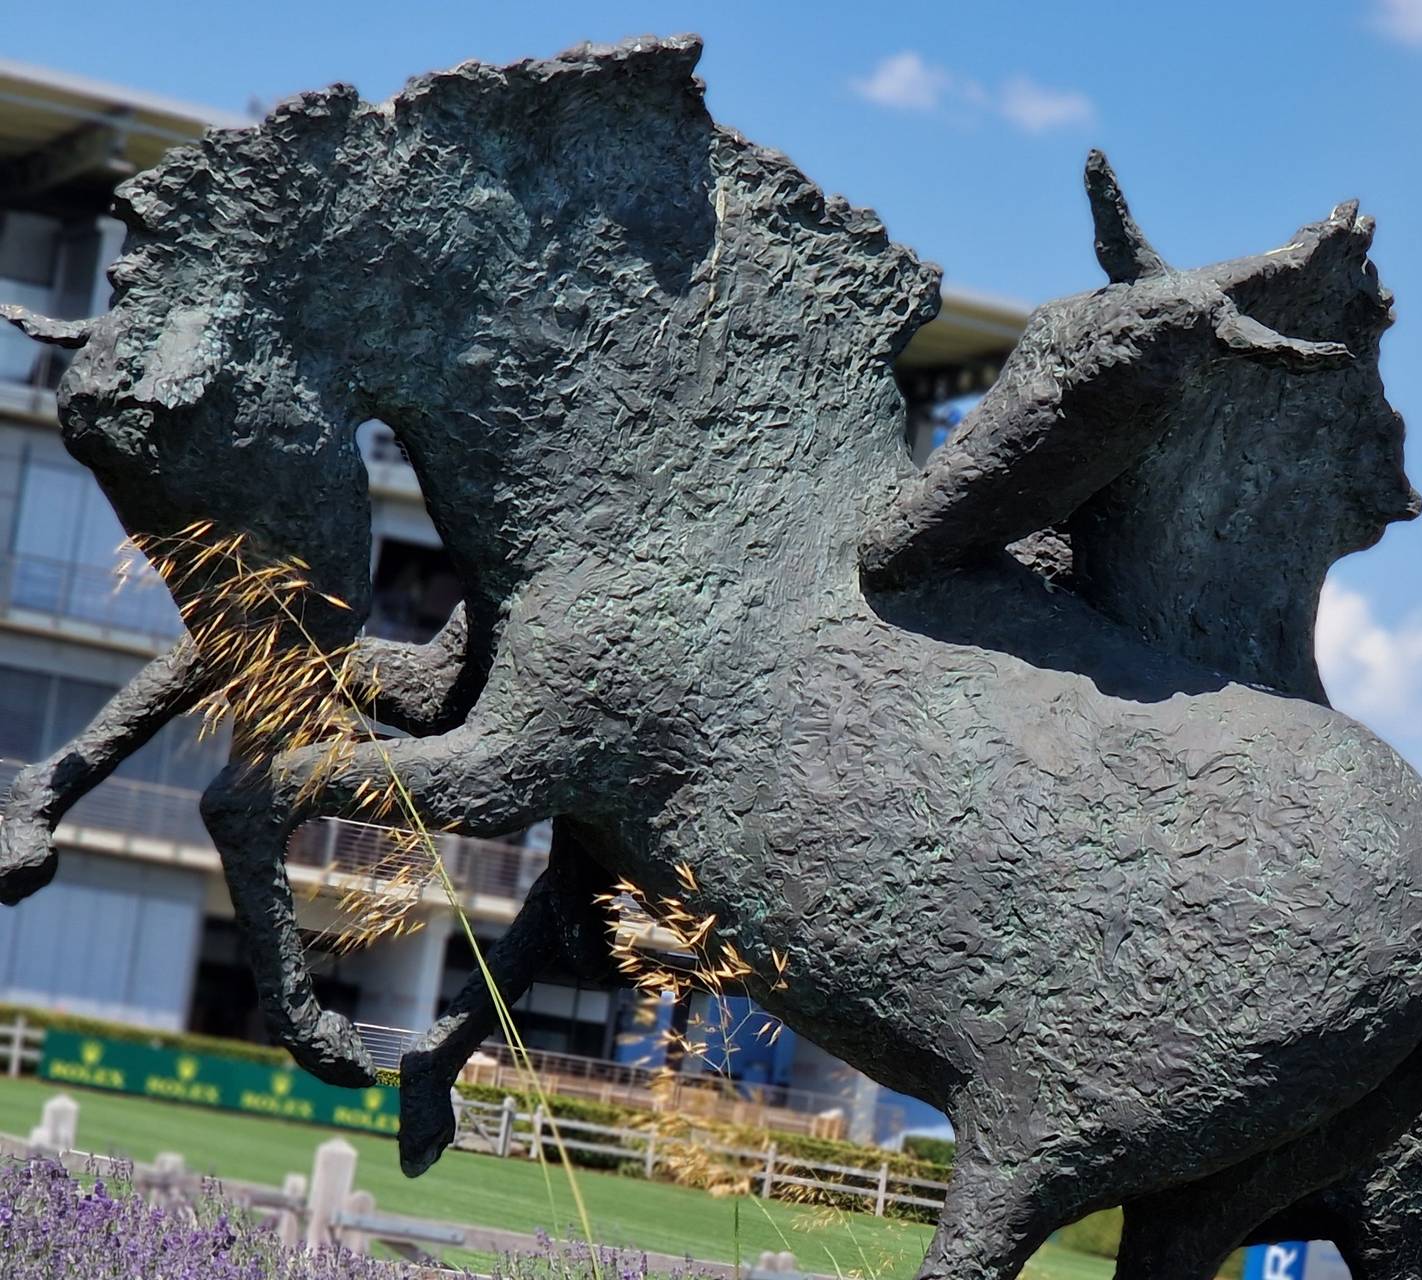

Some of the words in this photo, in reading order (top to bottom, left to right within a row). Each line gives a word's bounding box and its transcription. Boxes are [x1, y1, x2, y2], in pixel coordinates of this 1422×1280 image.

[50, 1060, 125, 1089] ROLEX
[144, 1075, 220, 1104] ROLEX
[240, 1090, 314, 1119] ROLEX
